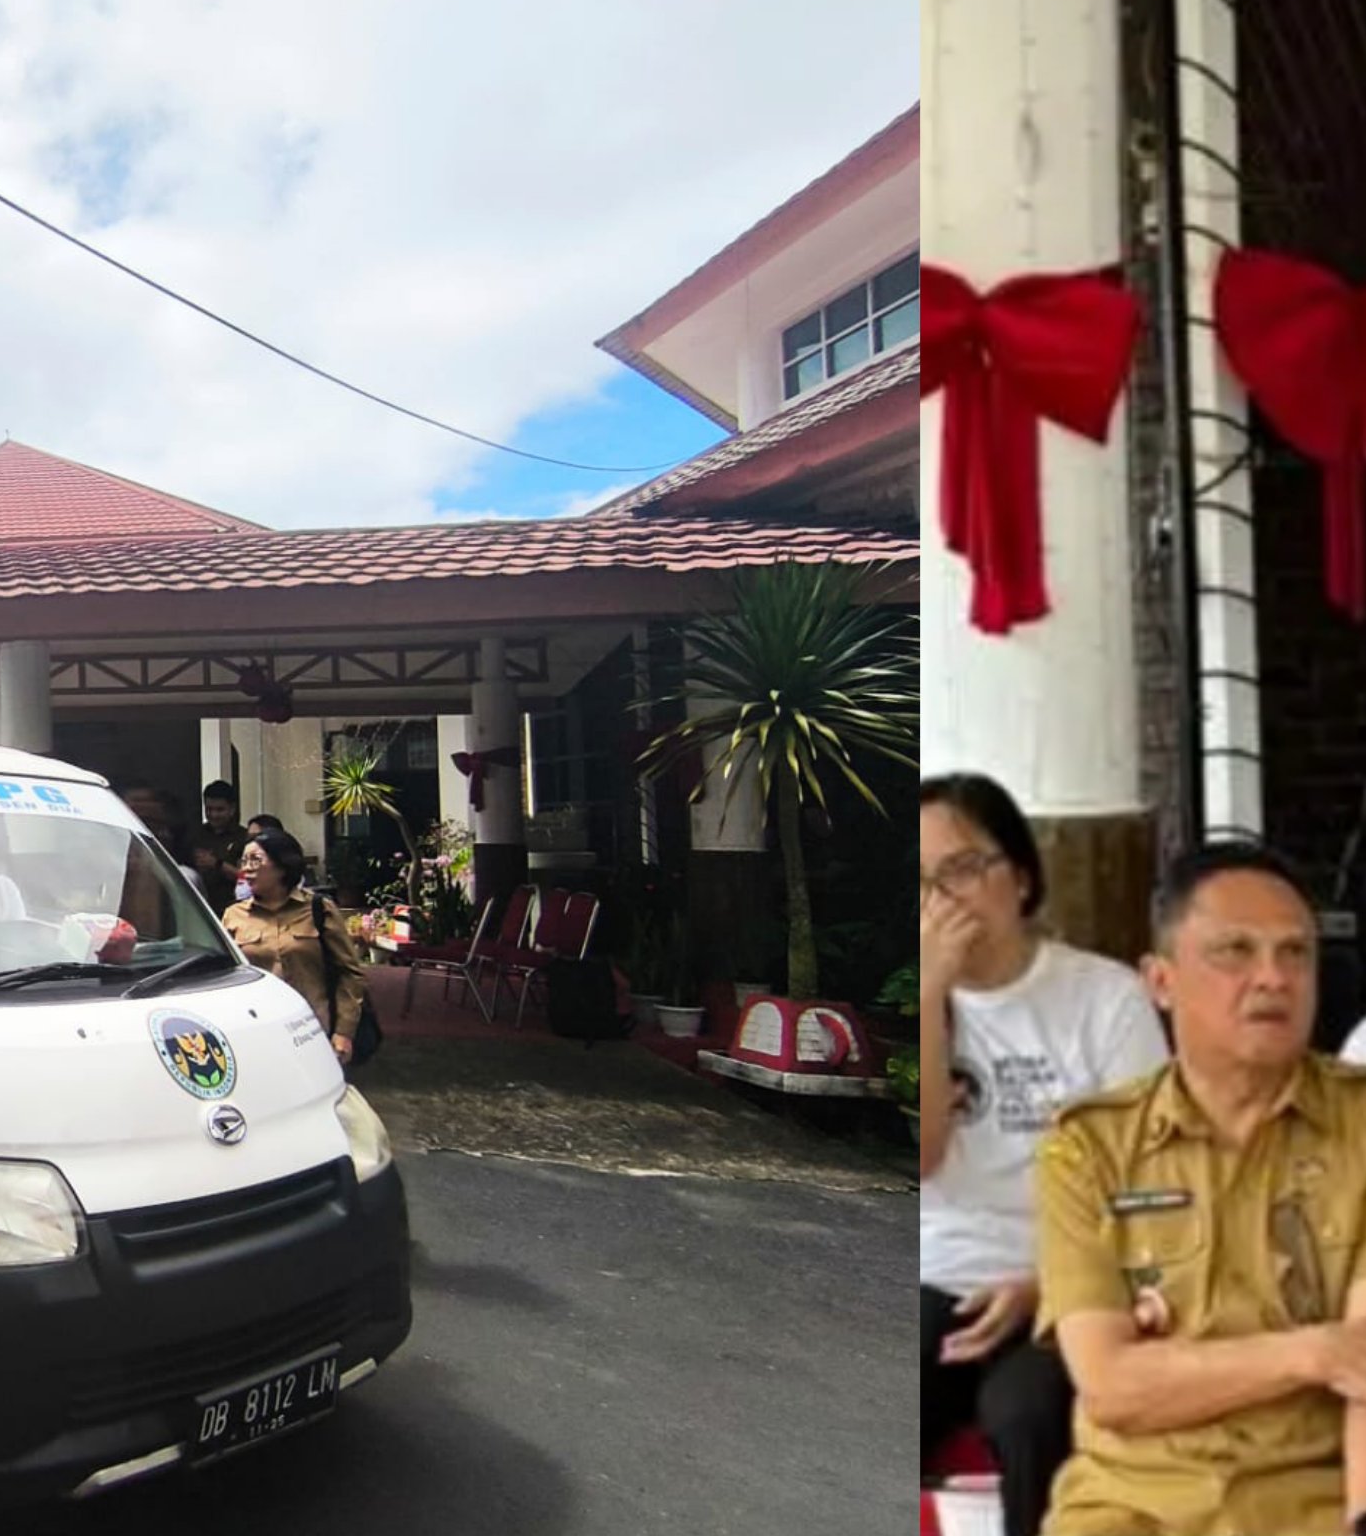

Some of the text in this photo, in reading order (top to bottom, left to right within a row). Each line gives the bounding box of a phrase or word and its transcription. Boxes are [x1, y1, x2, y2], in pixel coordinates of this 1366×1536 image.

[199, 1358, 337, 1443] DB 8112 LM
